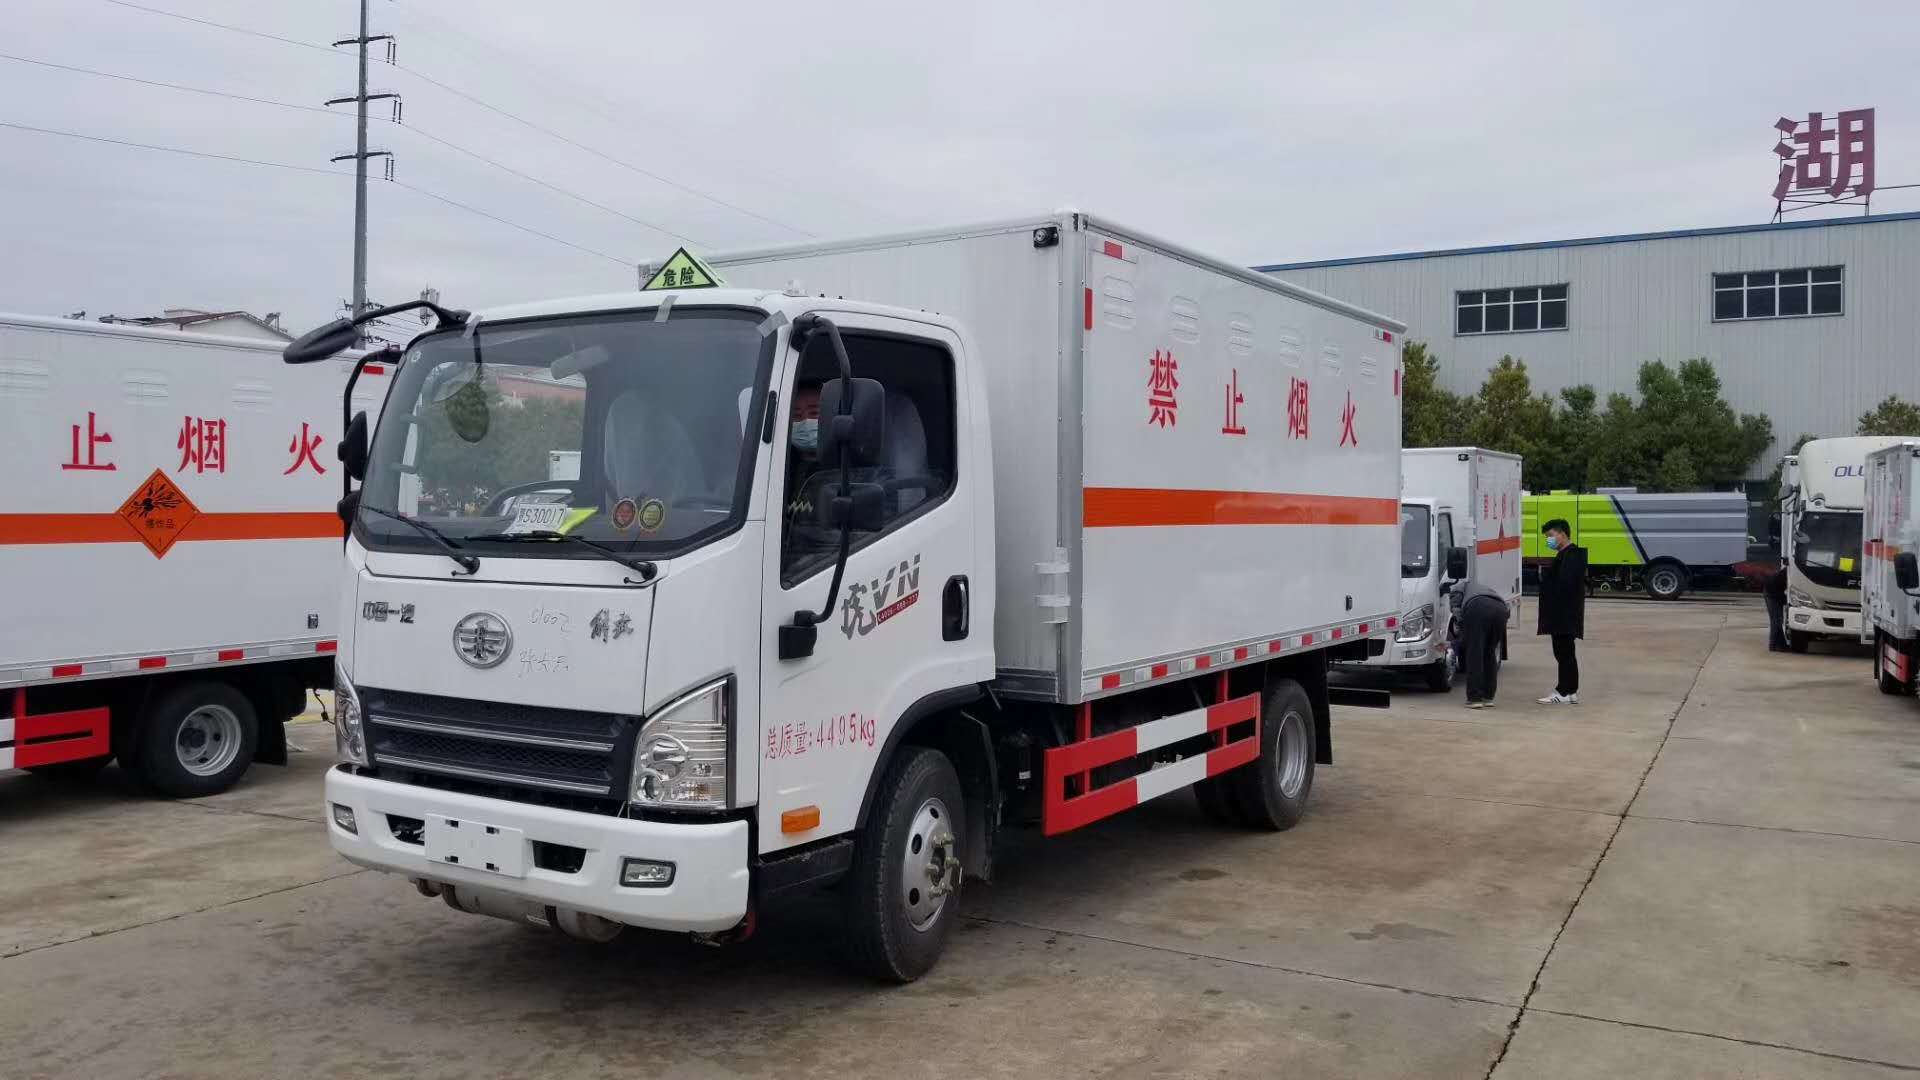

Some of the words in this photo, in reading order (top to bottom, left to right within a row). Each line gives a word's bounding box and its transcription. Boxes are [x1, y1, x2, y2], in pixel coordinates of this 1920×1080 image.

[1772, 108, 1875, 201] 湖
[663, 266, 695, 286] 危险
[1147, 347, 1359, 447] 禁止烟火
[62, 411, 327, 475] 止烟火
